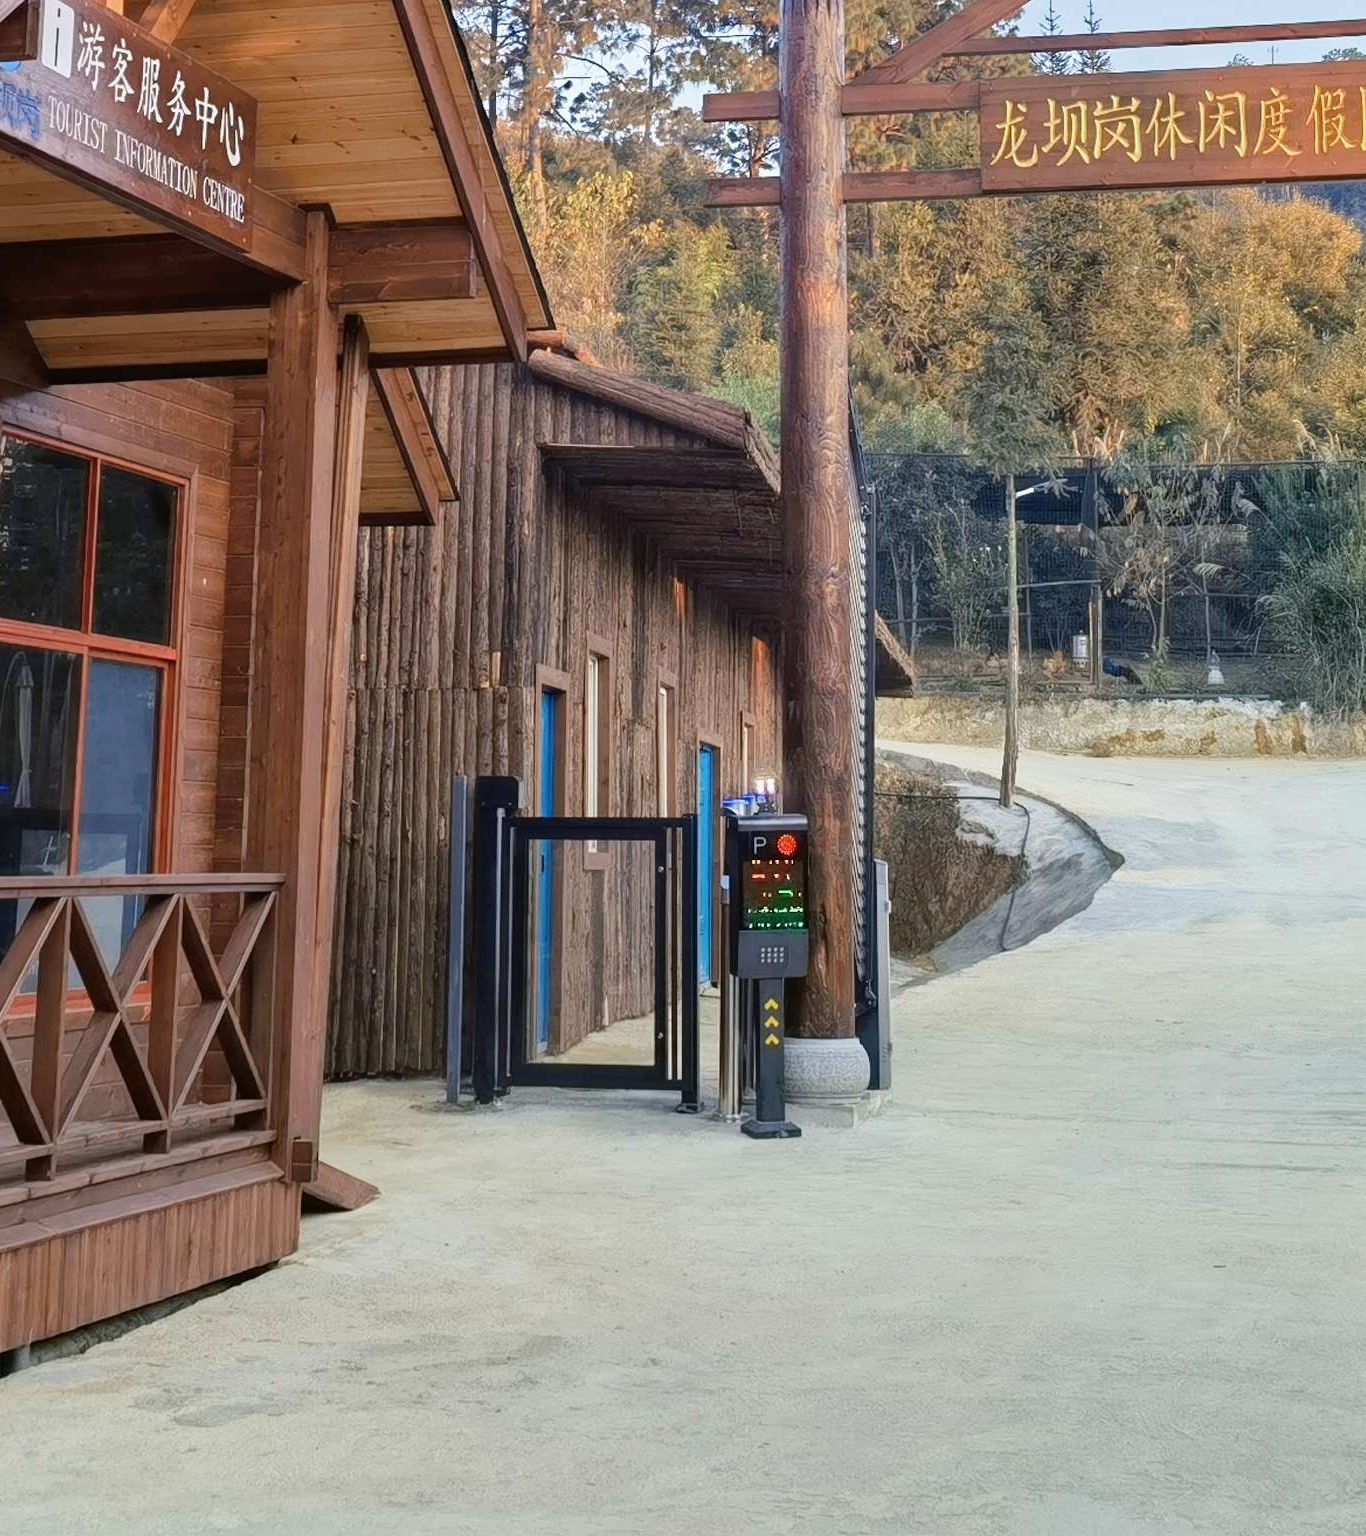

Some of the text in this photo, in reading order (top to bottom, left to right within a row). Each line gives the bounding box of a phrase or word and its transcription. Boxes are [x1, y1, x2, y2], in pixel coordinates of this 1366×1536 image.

[76, 21, 244, 167] 游客服务中心
[48, 95, 246, 224] TOURIST INFORMATION CENTRE
[753, 836, 767, 855] P
